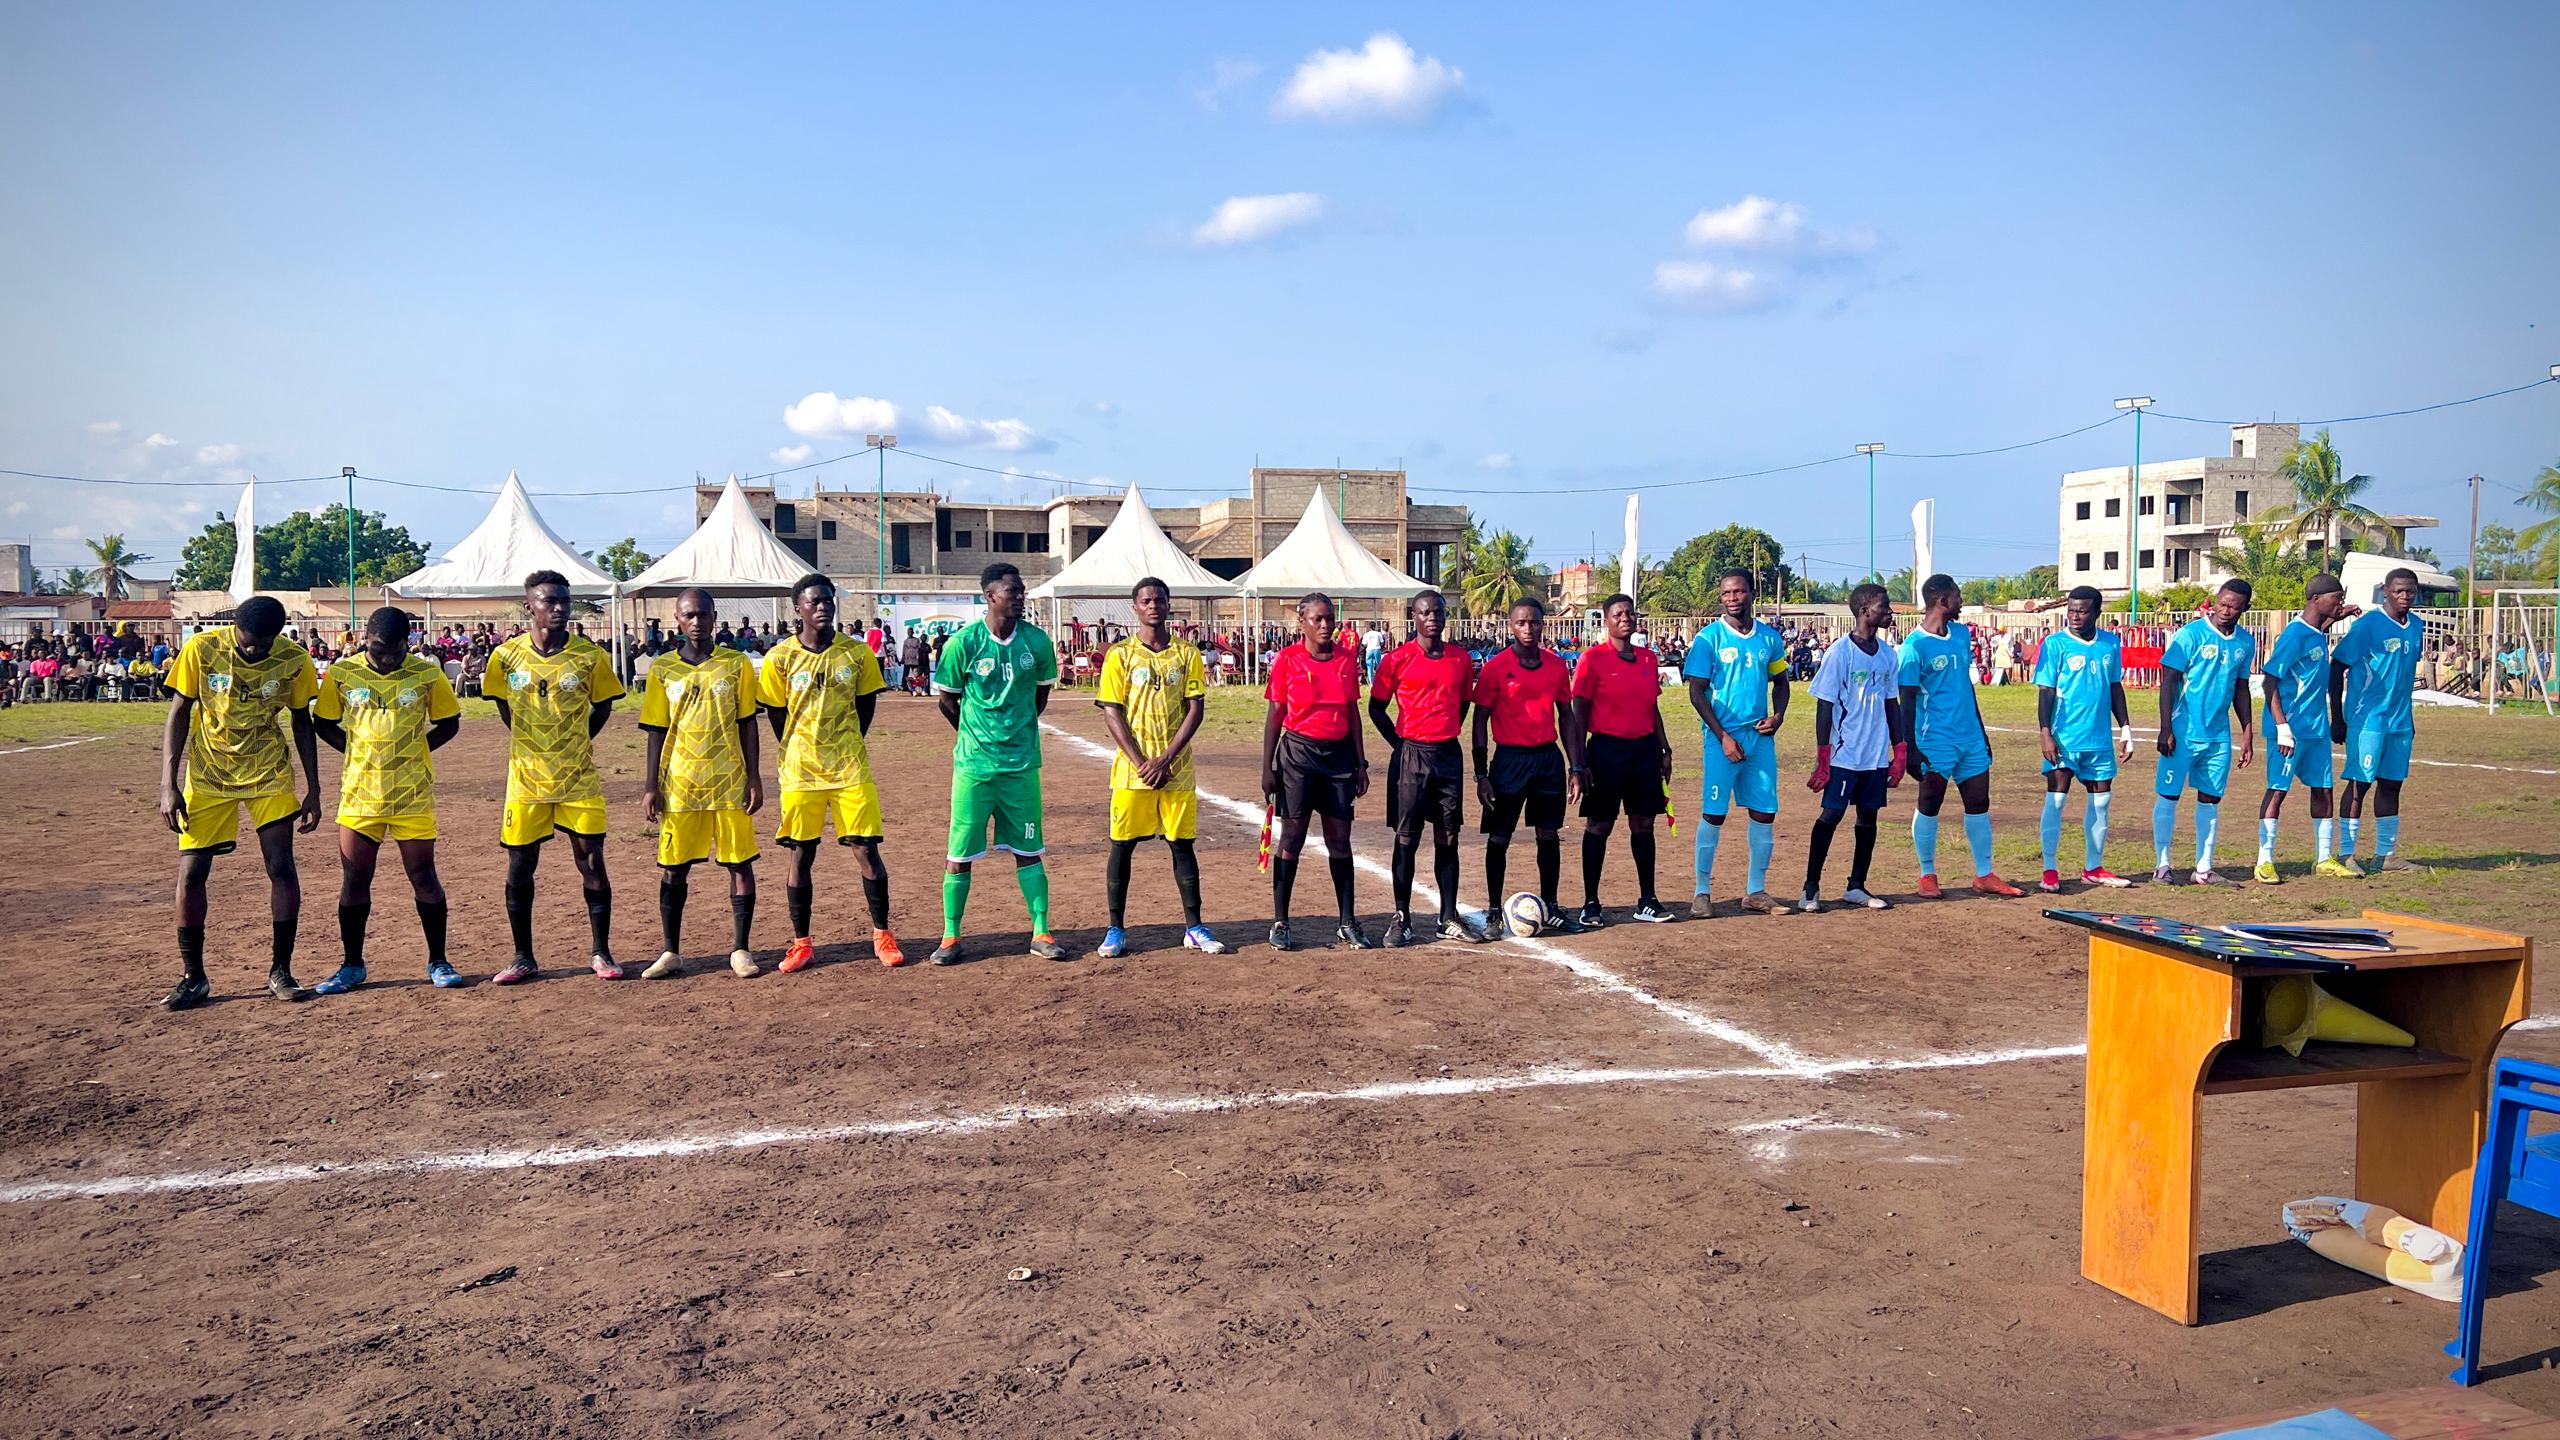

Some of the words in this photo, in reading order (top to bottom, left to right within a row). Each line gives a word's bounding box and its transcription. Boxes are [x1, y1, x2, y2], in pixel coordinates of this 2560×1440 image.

[1744, 652, 1752, 668] 3
[1001, 662, 1014, 682] 16
[240, 684, 250, 703] 6
[539, 679, 548, 698] 8
[692, 685, 700, 704] 7
[377, 696, 387, 715] 4
[2364, 754, 2373, 769] 6
[2165, 769, 2174, 784] 5
[1711, 785, 1719, 800] 3
[1840, 780, 1847, 797] 1
[506, 809, 513, 827] 8
[1024, 822, 1035, 840] 16
[664, 832, 673, 849] 7
